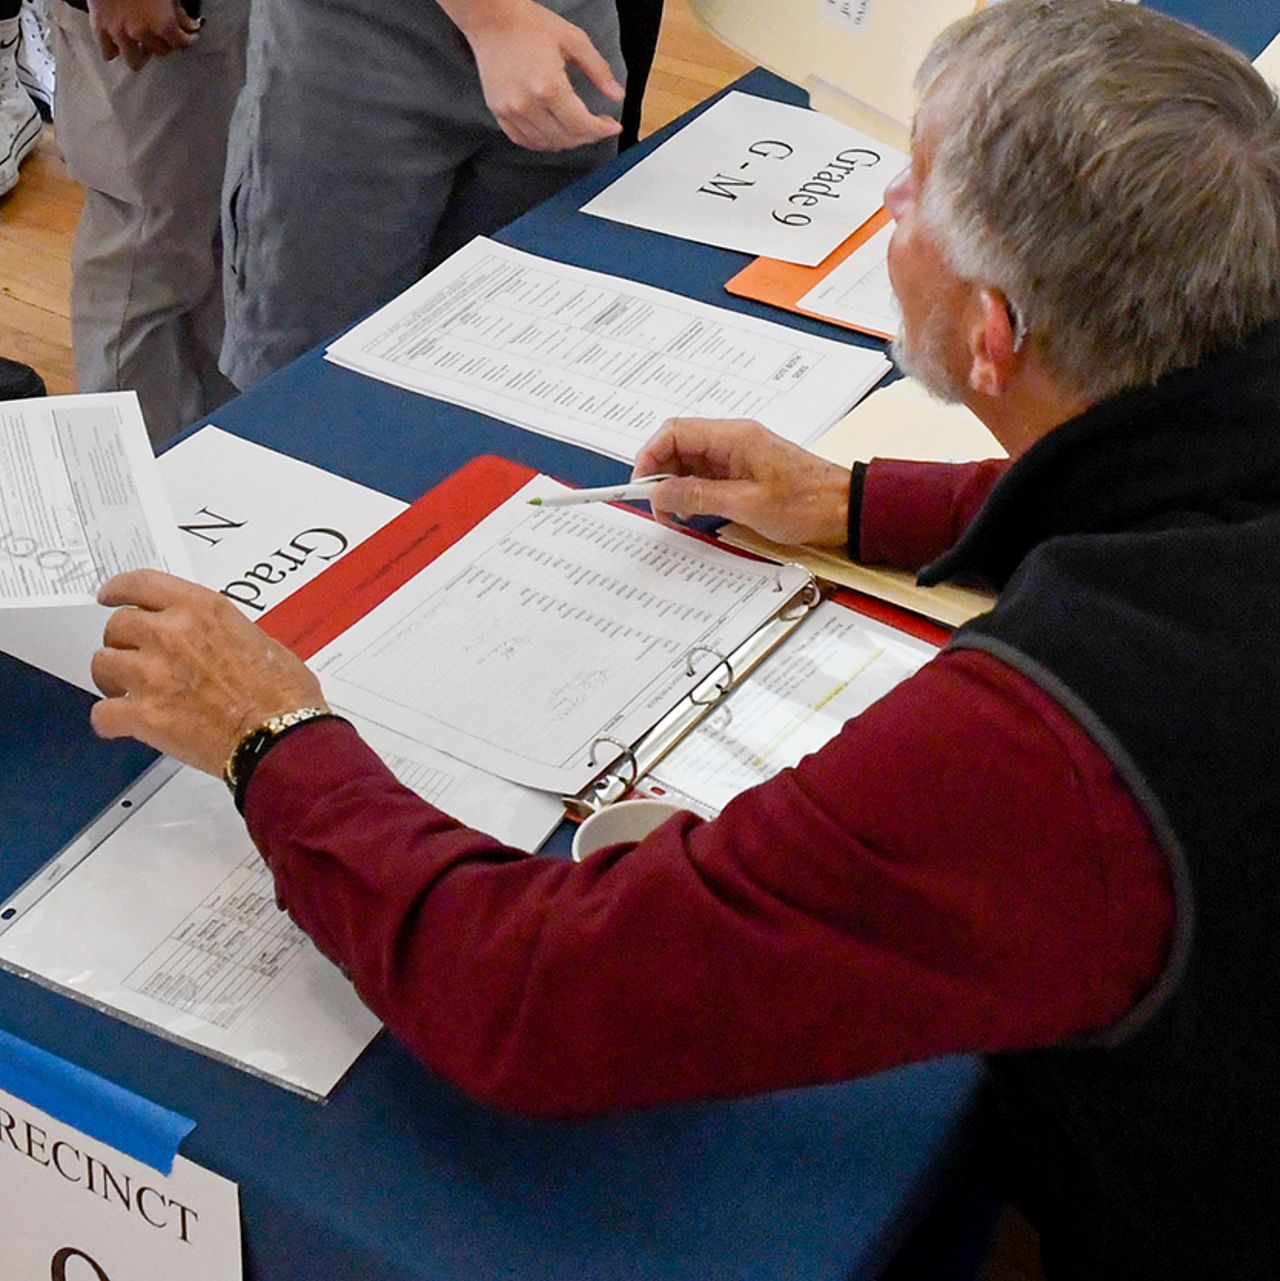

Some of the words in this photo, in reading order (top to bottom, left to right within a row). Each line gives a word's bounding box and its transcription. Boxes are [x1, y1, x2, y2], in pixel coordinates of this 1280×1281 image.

[749, 140, 794, 160] G
[696, 173, 757, 201] M
[788, 148, 881, 206] Grade
[772, 209, 812, 227] 9
[177, 505, 249, 548] N
[219, 527, 349, 612] Grad
